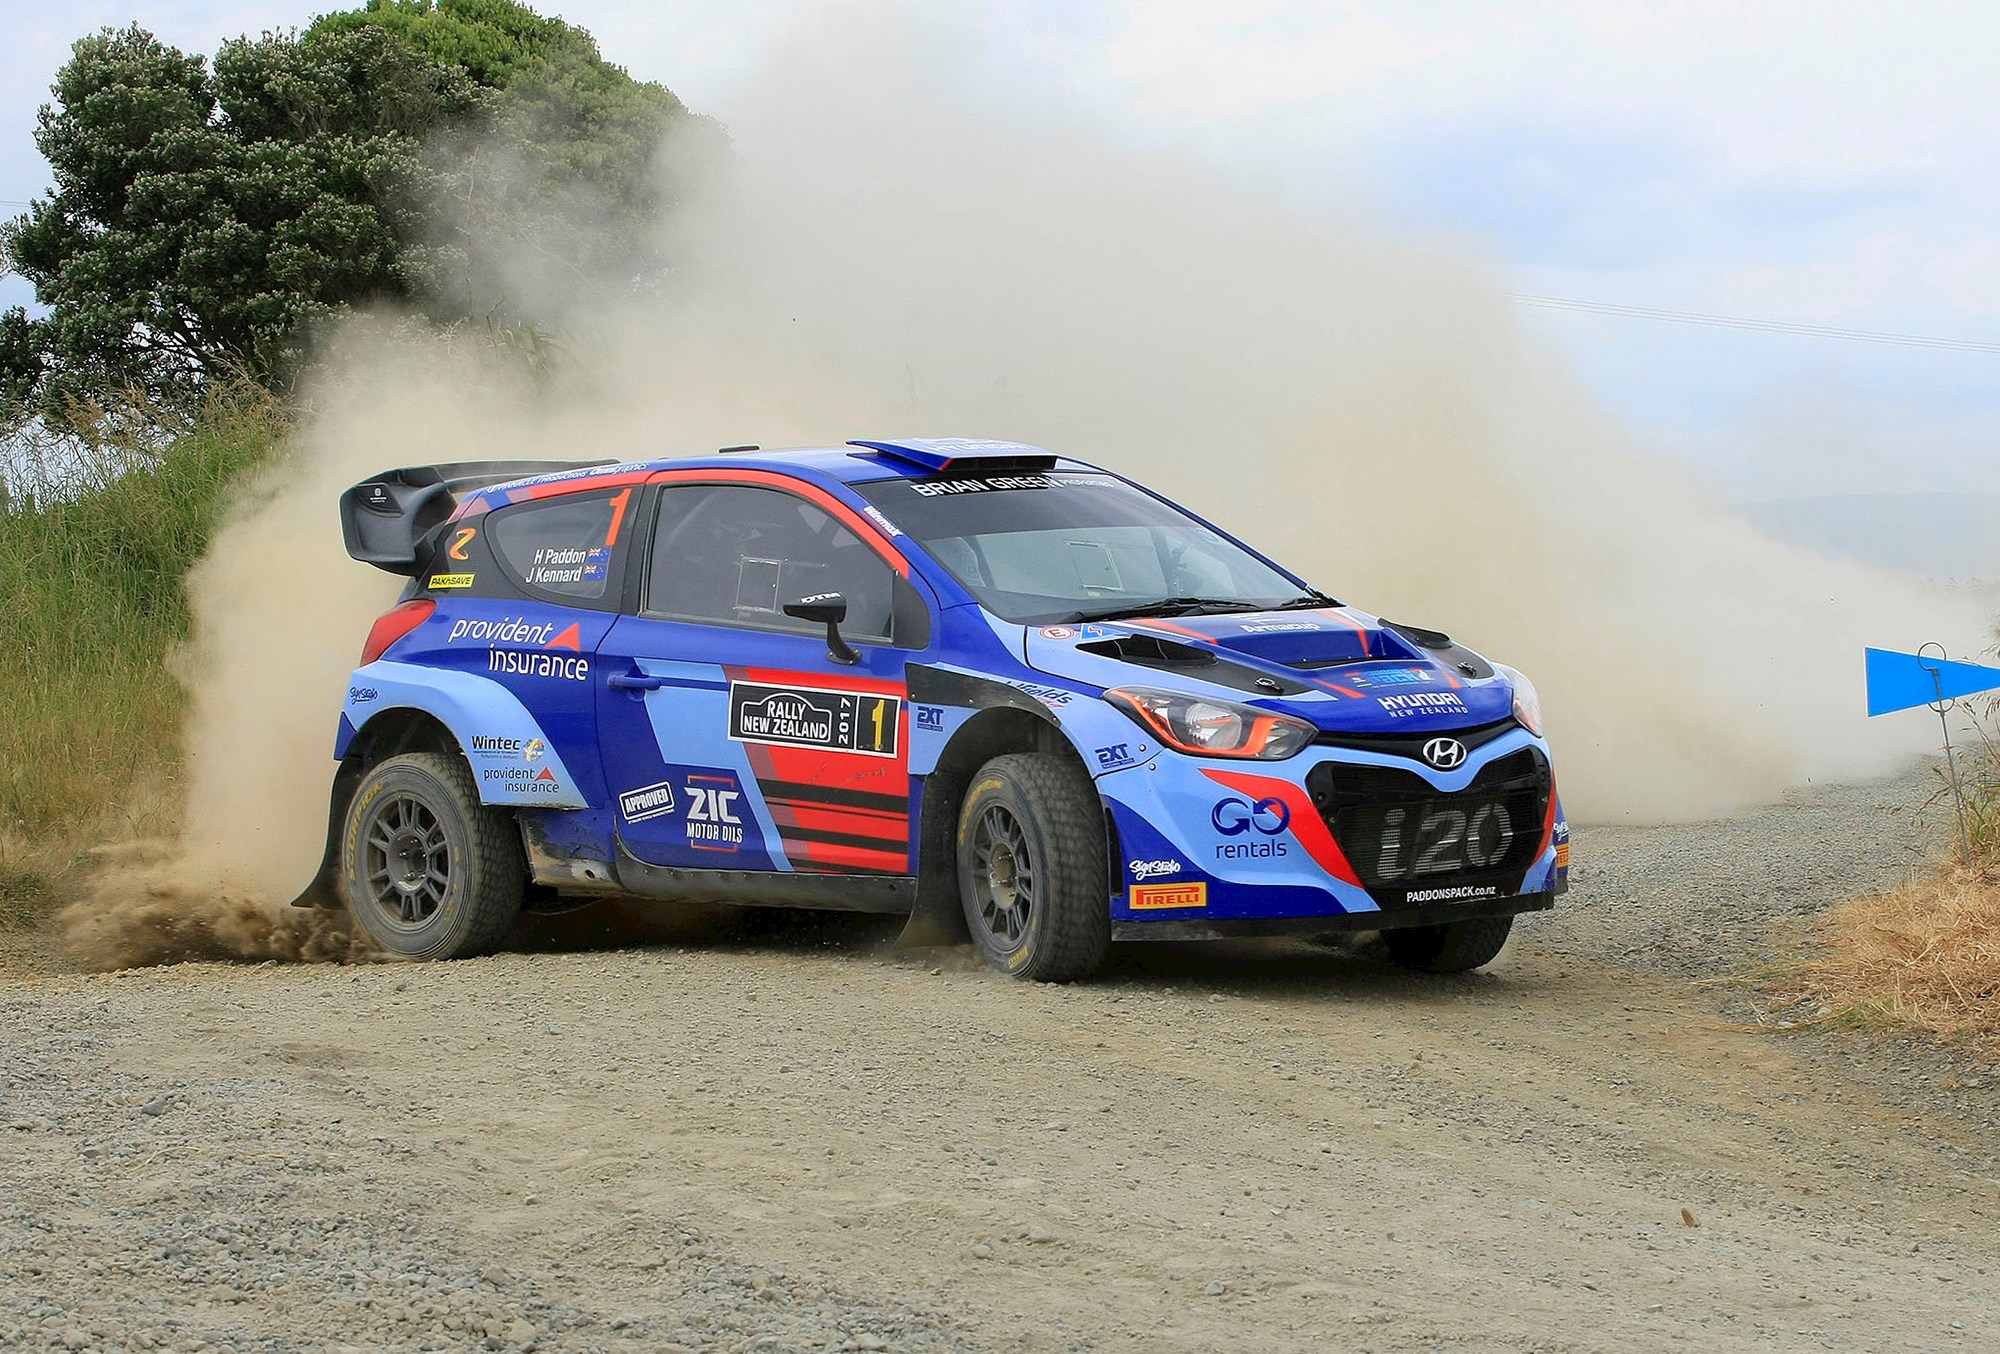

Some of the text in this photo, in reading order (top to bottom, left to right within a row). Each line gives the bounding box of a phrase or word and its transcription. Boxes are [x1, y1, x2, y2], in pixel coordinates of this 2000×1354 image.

[910, 479, 990, 498] BRIAN
[985, 476, 1064, 490] GREEN
[605, 488, 632, 546] 1
[533, 548, 587, 564] H Paddon
[525, 566, 583, 583] J Kennard
[447, 616, 554, 645] provident
[488, 643, 589, 681] insurance
[767, 700, 806, 721] RALLY
[1377, 692, 1464, 710] HYUNDAI
[838, 697, 851, 745] 2017
[1389, 706, 1468, 718] NEW ZEALAND
[743, 715, 828, 739] NEW ZEALAND
[871, 699, 885, 751] 1
[471, 735, 521, 750] Wintec
[484, 767, 535, 781] provident
[505, 780, 560, 793] insurance
[624, 788, 669, 813] APPROVED
[684, 787, 742, 824] ZIC
[686, 822, 743, 843] MOTOR OILS
[1216, 839, 1287, 859] rentals
[1136, 887, 1199, 905] PIRELLI
